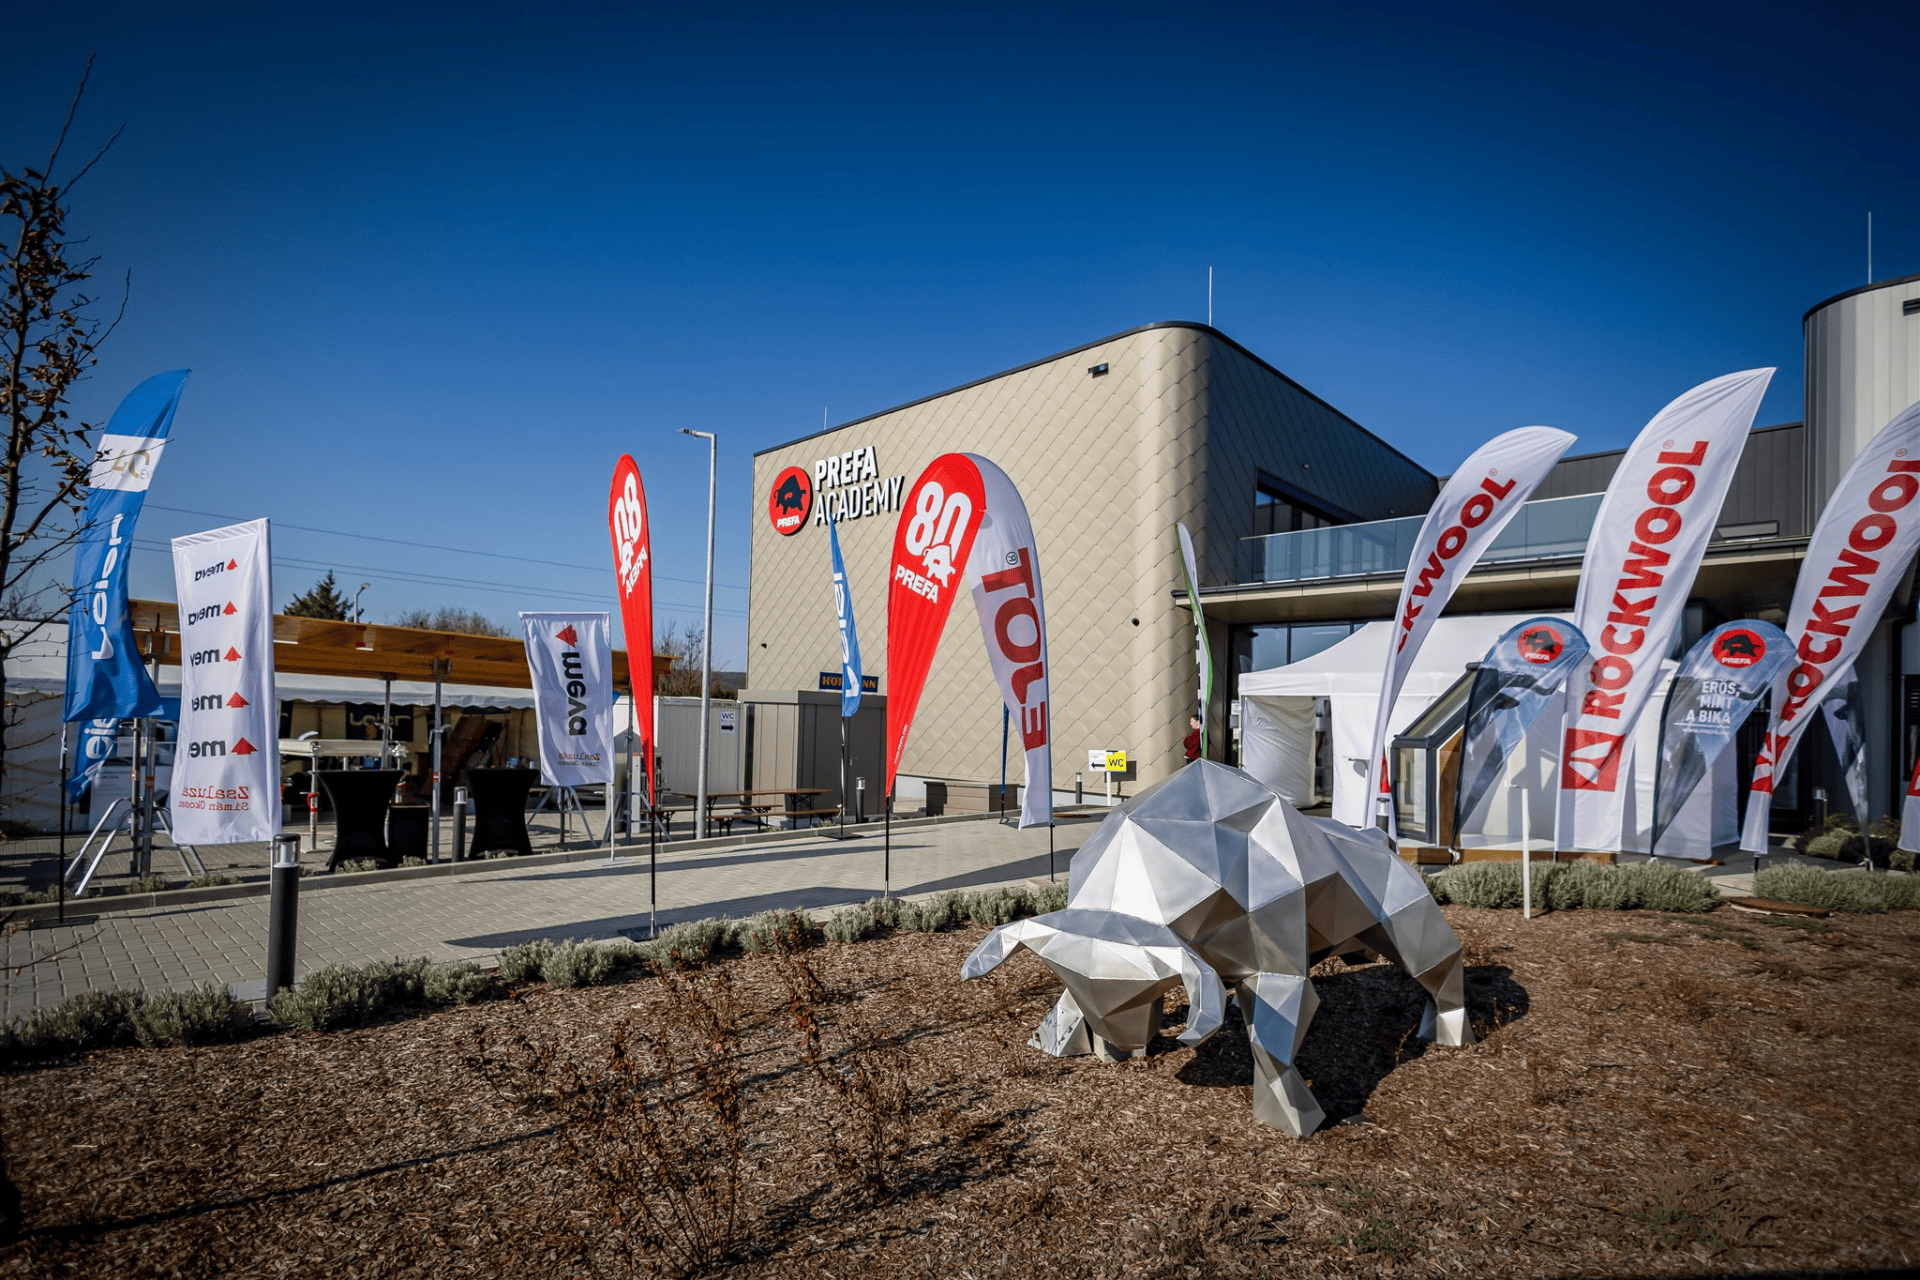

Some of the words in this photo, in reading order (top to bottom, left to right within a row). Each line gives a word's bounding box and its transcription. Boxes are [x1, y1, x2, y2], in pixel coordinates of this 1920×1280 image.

[814, 445, 878, 491] PREFA
[813, 475, 904, 527] ACADEMY
[776, 514, 801, 528] PREFA
[905, 481, 972, 563] 80
[895, 564, 939, 604] PREFA
[1721, 657, 1752, 665] PREFA
[721, 712, 735, 720] WC
[1685, 708, 1696, 722] A
[1698, 710, 1731, 724] BIKA
[1108, 758, 1124, 768] WC
